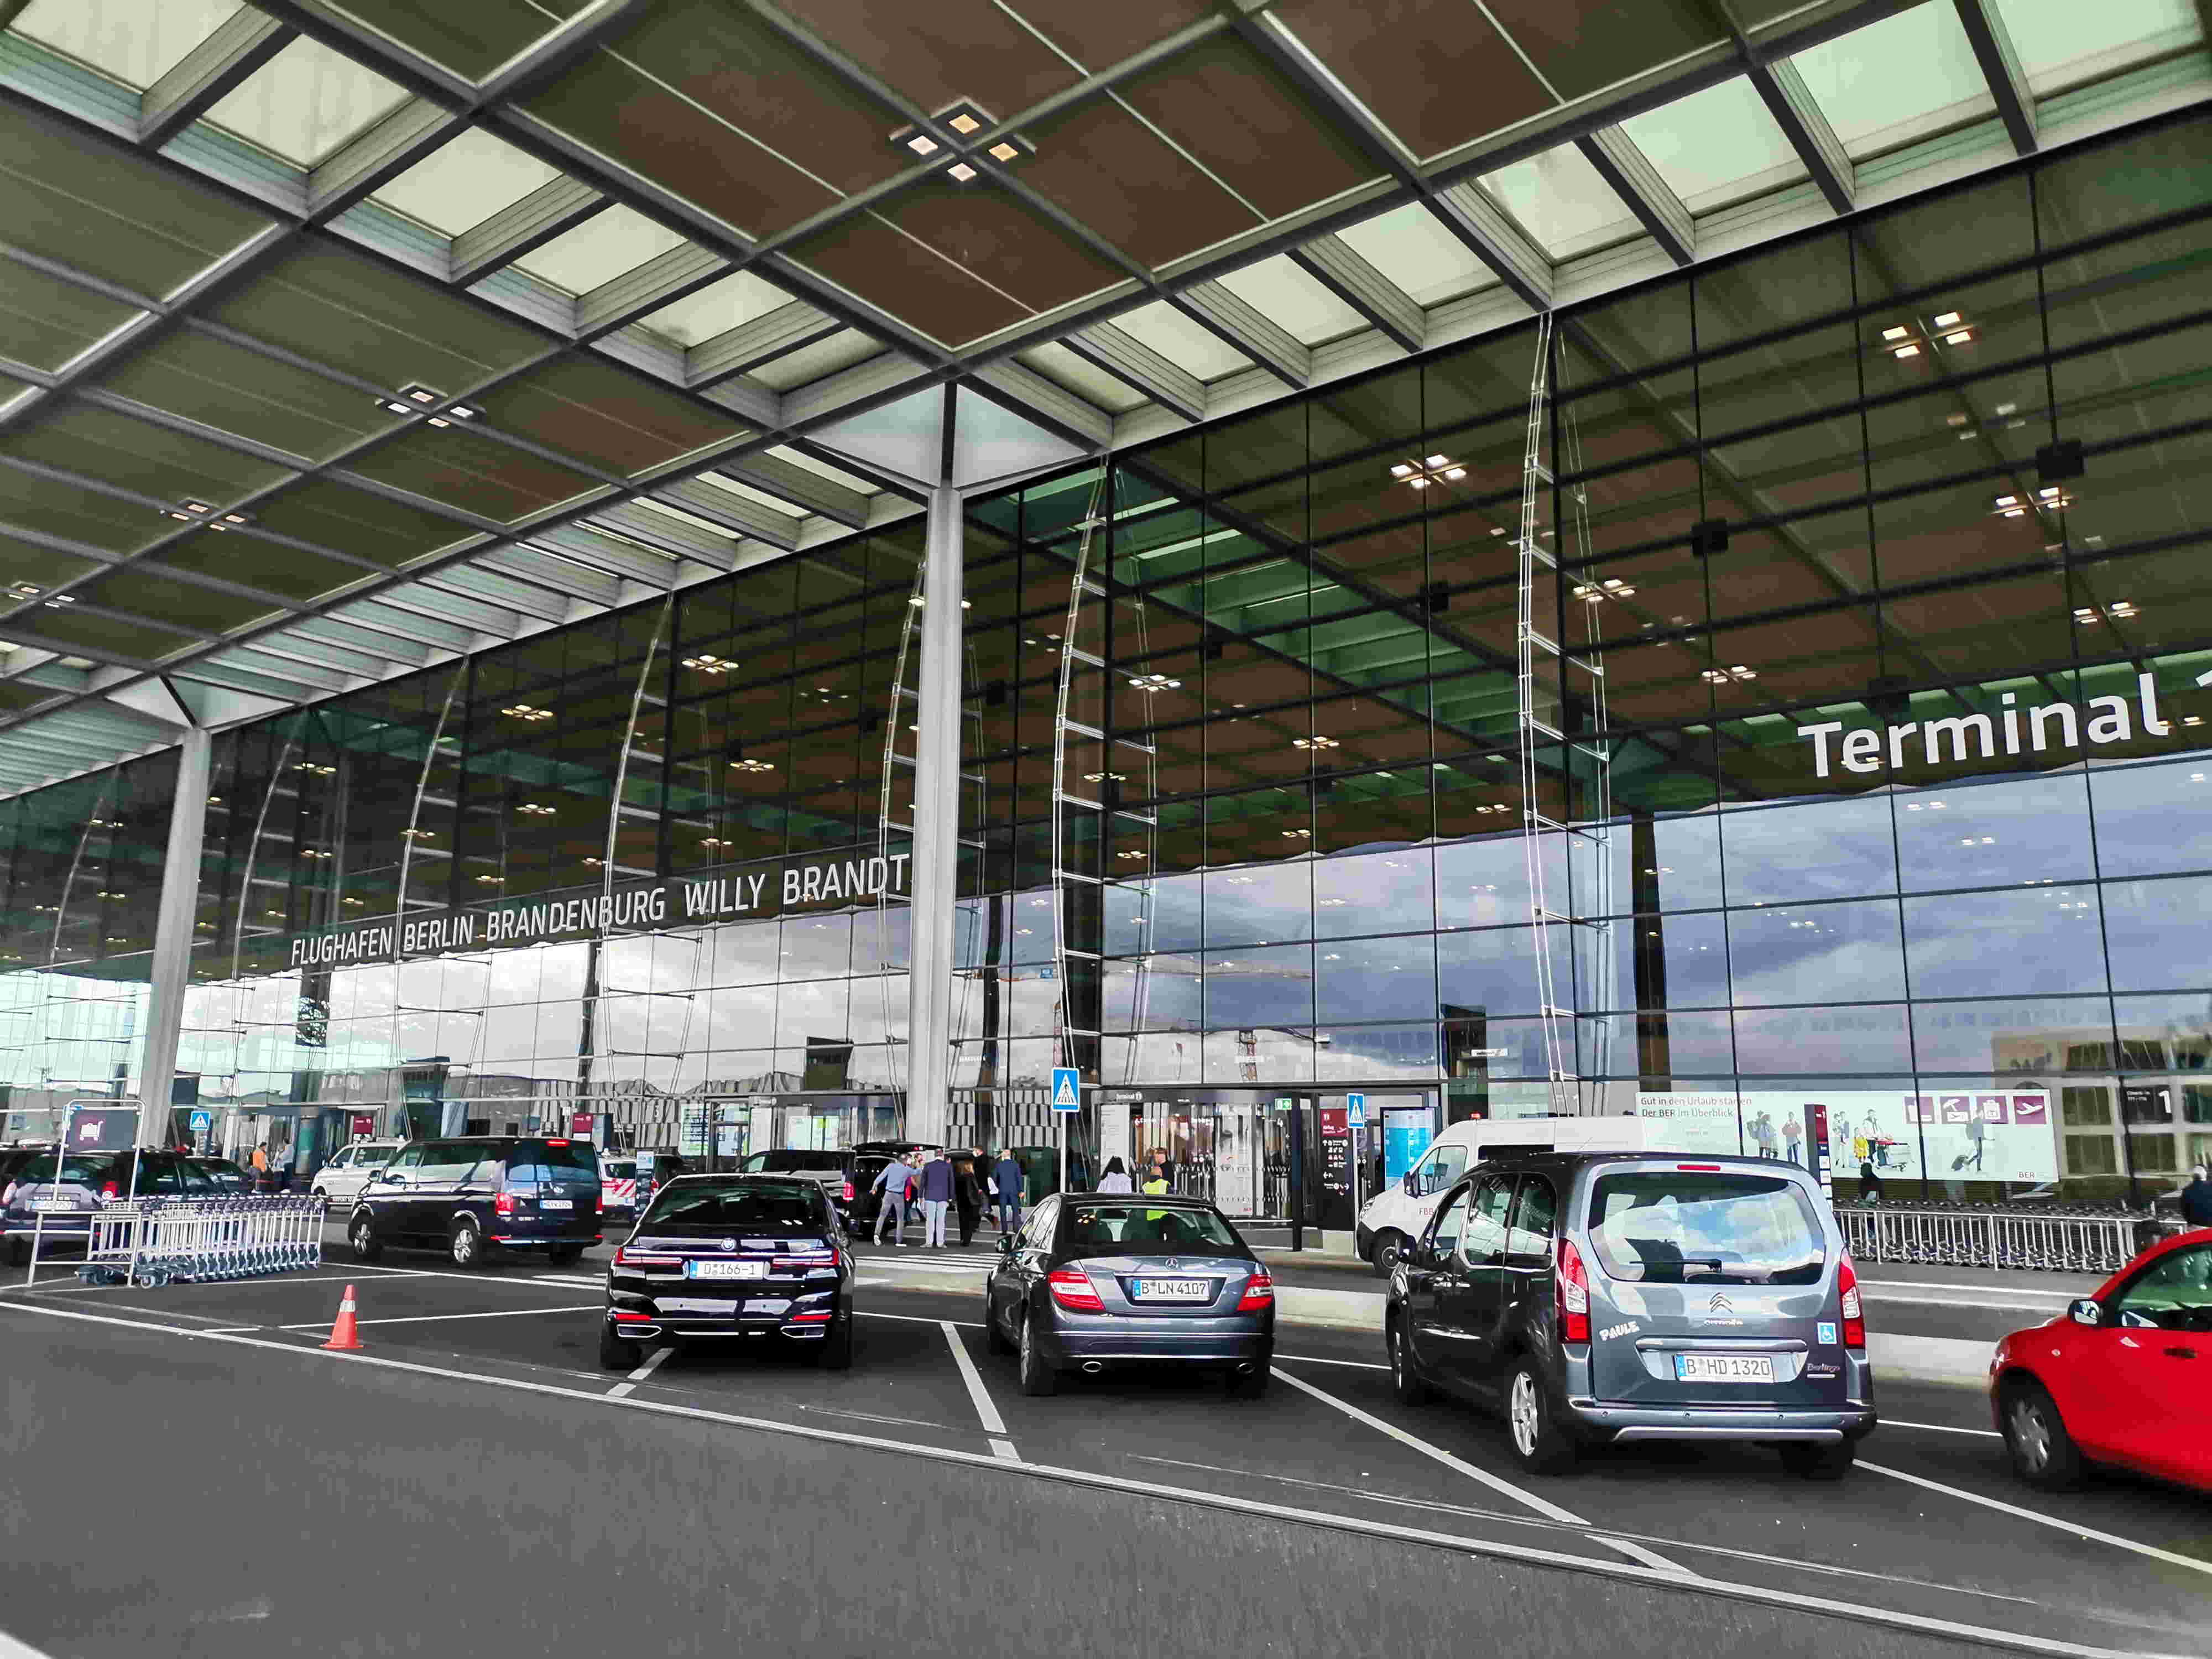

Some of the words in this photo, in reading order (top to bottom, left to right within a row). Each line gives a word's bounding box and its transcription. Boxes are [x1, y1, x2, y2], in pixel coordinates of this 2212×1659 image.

[1797, 672, 2169, 778] Terminal
[291, 926, 394, 966] FLUGHAFEN
[404, 914, 474, 952] BERLIN
[486, 887, 666, 942] BRANDENBURG
[685, 873, 766, 917] WILLY
[783, 853, 910, 905] BRANDT
[1641, 1097, 1656, 1105] Gut
[1658, 1097, 1667, 1105] in
[1668, 1097, 1686, 1105] den
[1687, 1097, 1717, 1105] Urlaub
[1719, 1097, 1752, 1106] staren
[2158, 1090, 2172, 1113] 1
[1691, 1108, 1734, 1118] Überblick
[1419, 1207, 1434, 1215] FBB
[719, 1264, 755, 1275] 166-1
[1141, 1283, 1150, 1294] B
[1157, 1284, 1175, 1295] LN
[1177, 1283, 1206, 1295] 4107
[1687, 1358, 1696, 1374] B
[1707, 1360, 1728, 1375] HD
[1731, 1360, 1771, 1376] 1320
